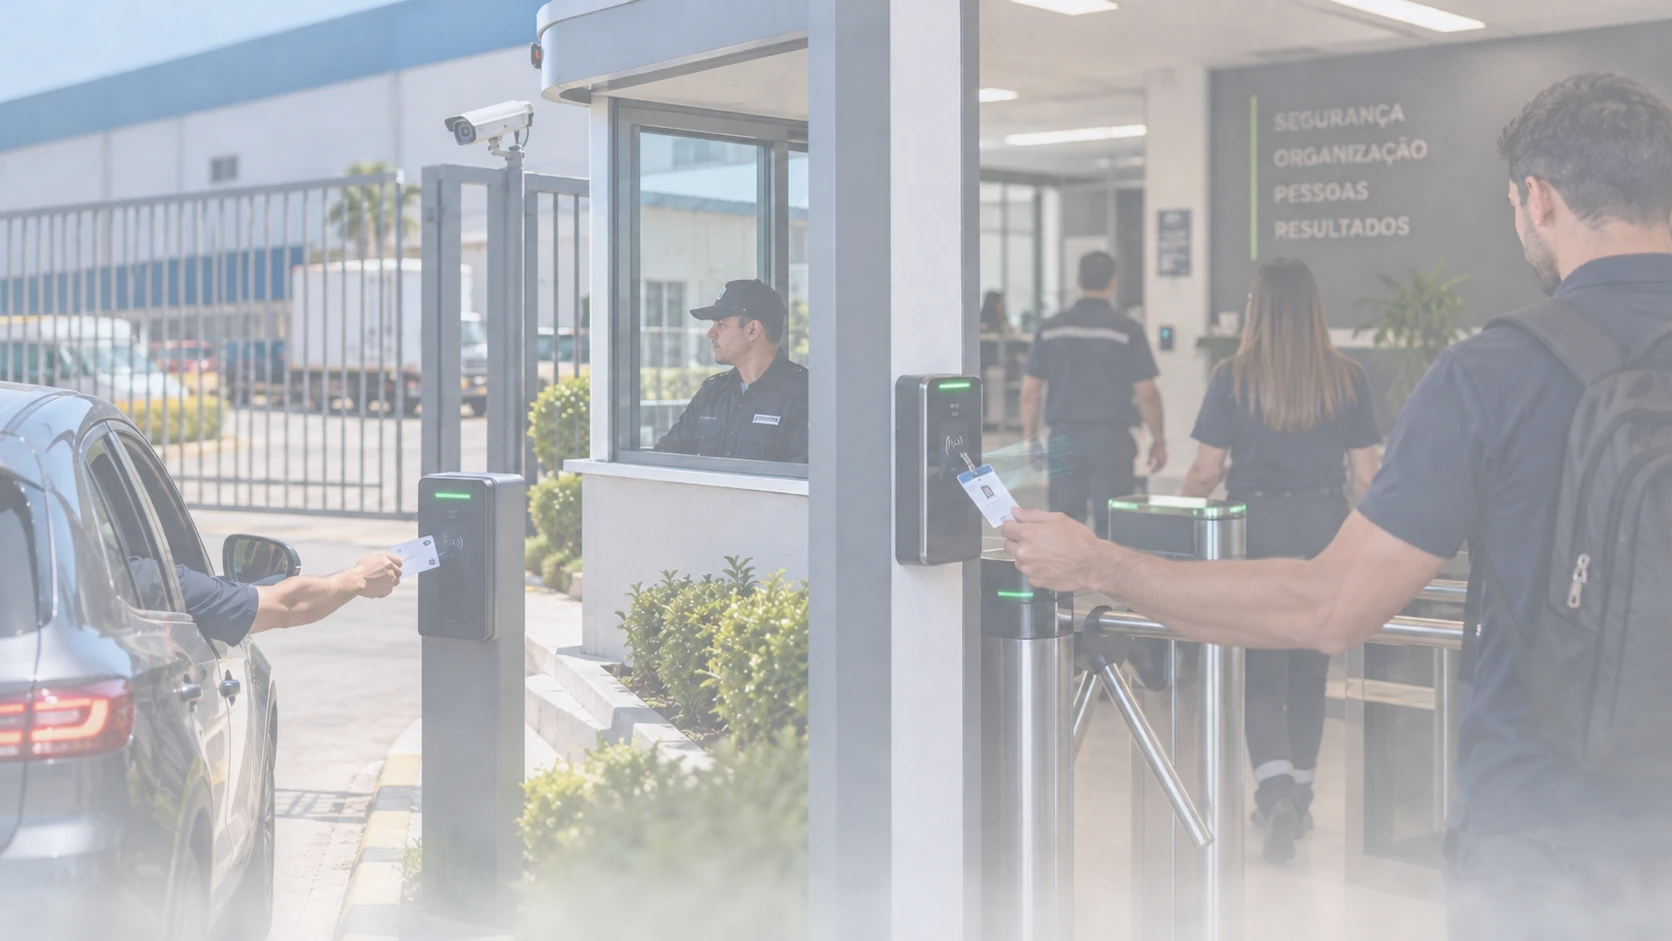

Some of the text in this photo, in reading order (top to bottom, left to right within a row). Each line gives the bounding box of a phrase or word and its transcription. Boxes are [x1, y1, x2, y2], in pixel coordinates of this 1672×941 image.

[1274, 103, 1405, 131] SEGURANÇA
[1274, 137, 1427, 166] ORGANIZAÇÃO
[1274, 181, 1369, 204] PESSOAS
[1274, 216, 1410, 239] RESULTADOS
